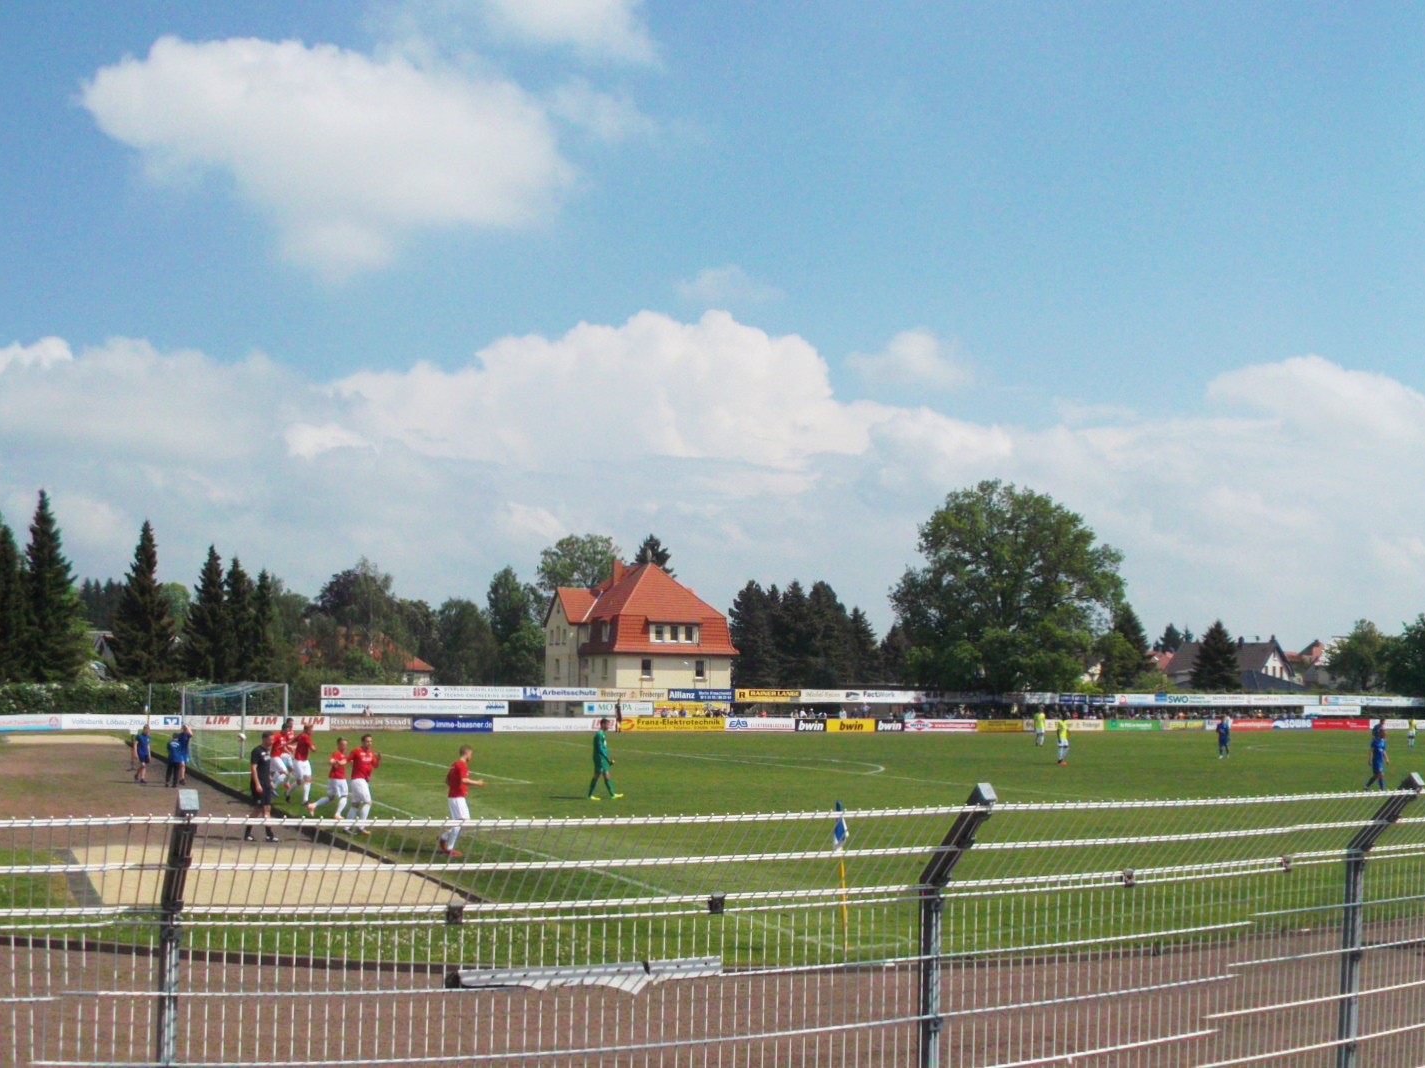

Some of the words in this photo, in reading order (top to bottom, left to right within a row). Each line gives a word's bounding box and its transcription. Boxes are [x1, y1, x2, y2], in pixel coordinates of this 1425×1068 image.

[542, 689, 597, 697] Arbeitsschutz
[205, 716, 231, 725] LIM
[253, 716, 278, 725] LIM
[300, 716, 325, 725] LIM
[435, 720, 493, 729] immo-baasner.de
[1284, 719, 1312, 728] SOWAG
[798, 720, 824, 731] bwin
[839, 721, 864, 731] bwin
[877, 721, 902, 731] bwin
